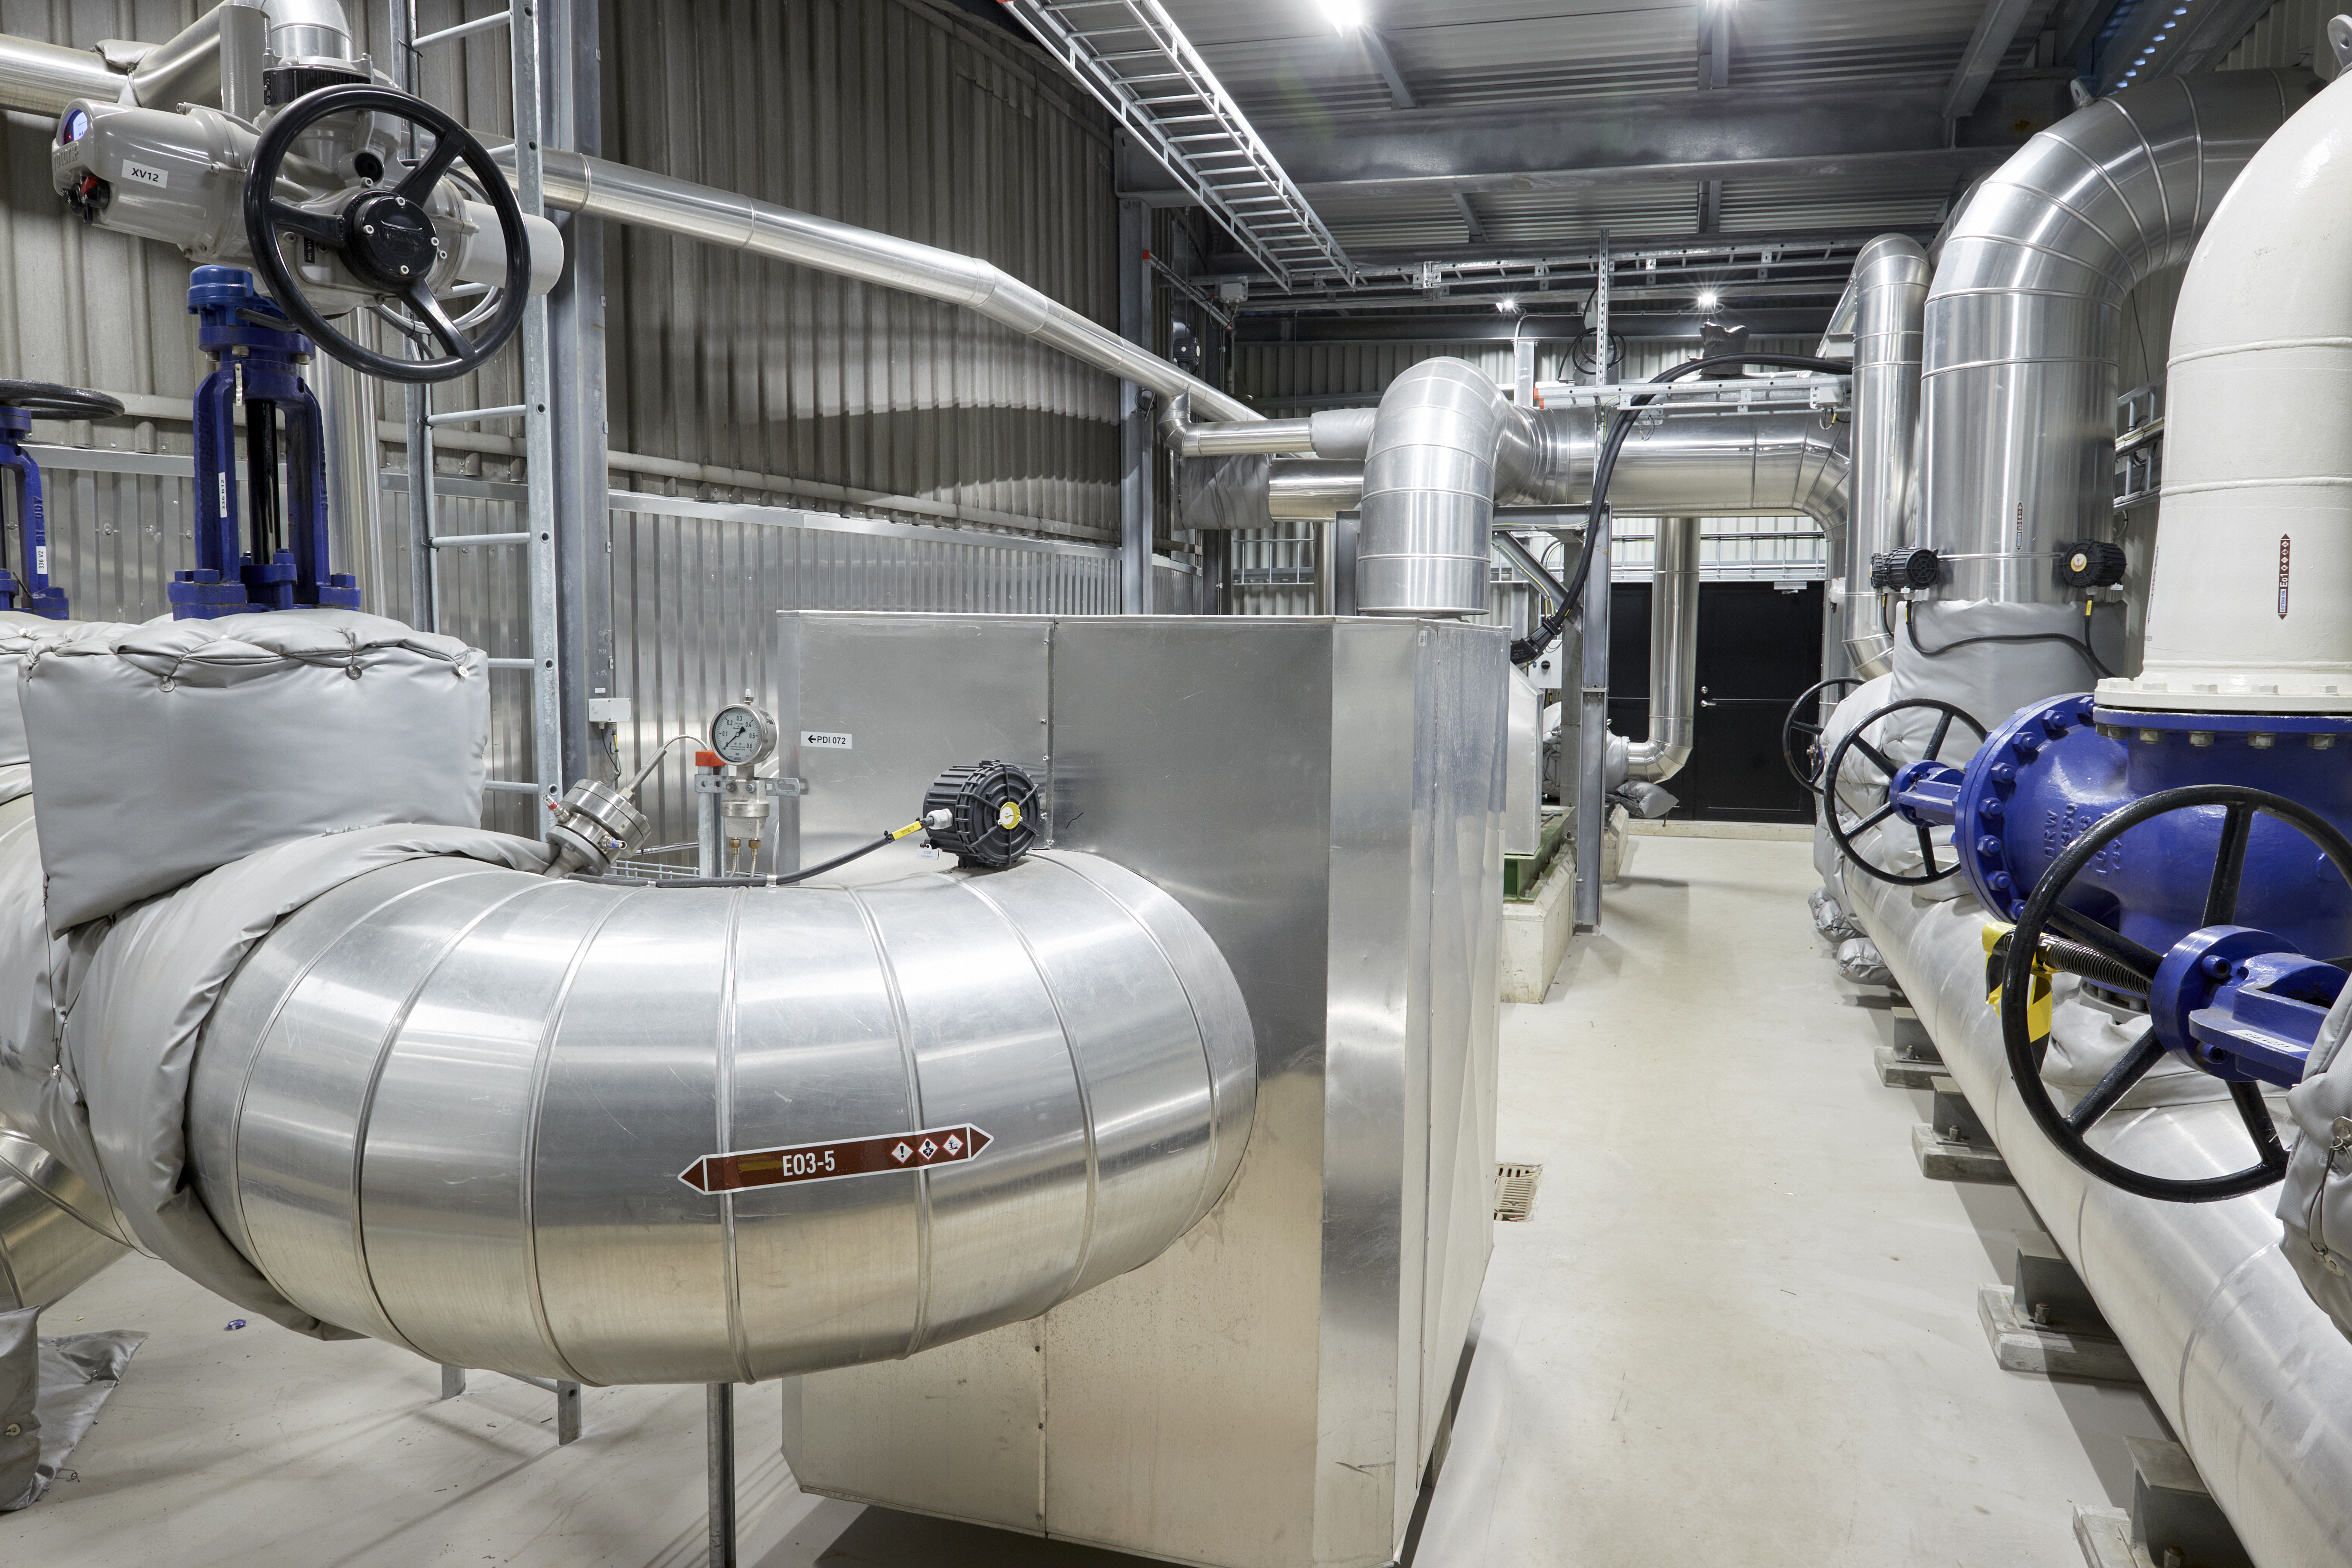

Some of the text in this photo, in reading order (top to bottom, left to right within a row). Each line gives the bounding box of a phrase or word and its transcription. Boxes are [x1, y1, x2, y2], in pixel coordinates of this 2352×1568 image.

[132, 168, 159, 182] XV12
[2279, 573, 2288, 587] Eo1
[2262, 1039, 2290, 1047] V231
